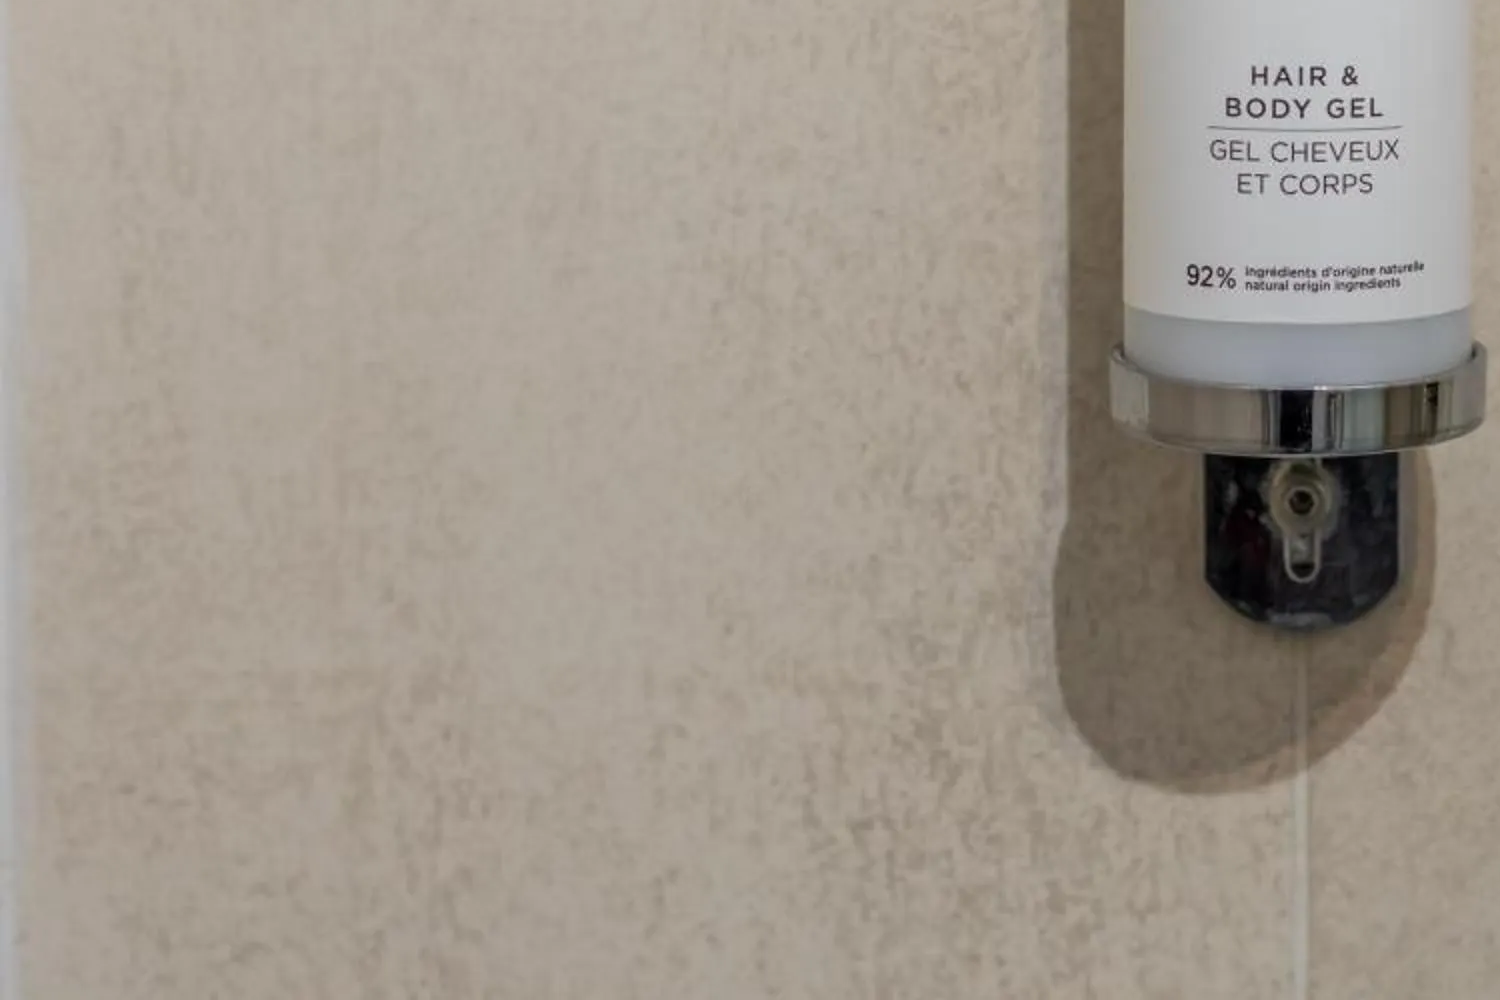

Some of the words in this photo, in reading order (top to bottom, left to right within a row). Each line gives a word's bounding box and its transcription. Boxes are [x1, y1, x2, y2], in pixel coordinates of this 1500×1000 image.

[1250, 64, 1328, 87] HAIR
[1341, 65, 1360, 87] &
[1225, 96, 1312, 119] BODY
[1326, 97, 1384, 119] GEL
[1209, 138, 1261, 162] GEL
[1270, 138, 1400, 163] CHEVEUX
[1236, 172, 1271, 195] ET
[1279, 172, 1374, 196] CORPS
[1185, 262, 1237, 290] 92%
[1244, 279, 1289, 292] natural
[1293, 279, 1331, 294] origin
[1335, 278, 1401, 292] ingredients
